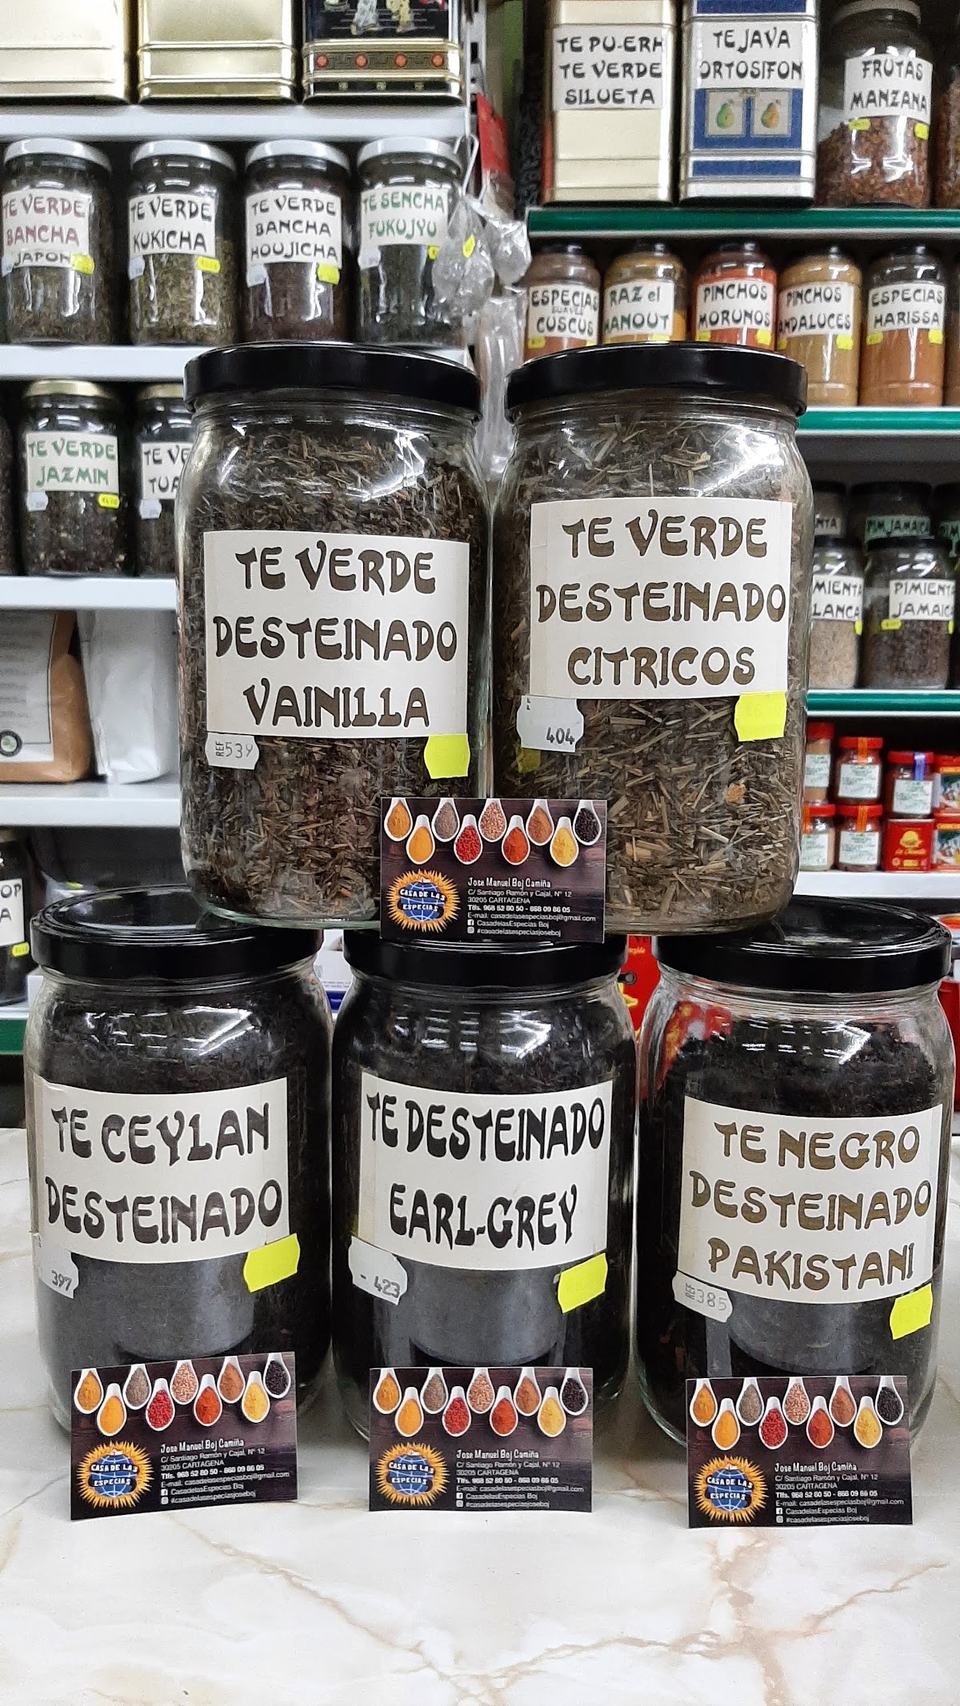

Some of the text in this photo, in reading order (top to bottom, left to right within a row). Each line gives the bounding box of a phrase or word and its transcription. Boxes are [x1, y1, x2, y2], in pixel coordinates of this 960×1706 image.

[557, 36, 662, 53] TE PU-ERH
[713, 27, 791, 53] TE JAVA
[560, 60, 662, 79] TE VERDE
[700, 60, 803, 80] ORTOSIFON
[862, 59, 923, 81] FRUTAS
[564, 88, 655, 105] SILUETA
[850, 89, 928, 114] MANZANA
[3, 193, 85, 219] TE VERDE
[131, 196, 212, 222] TE VERDE
[251, 195, 337, 216] TE VERDE
[362, 192, 445, 215] TE SENCHA
[6, 225, 80, 246] BANCHA
[256, 220, 332, 237] BANCHA
[133, 230, 207, 252] KUKICHA
[251, 241, 338, 261] HOUJICHA
[531, 289, 598, 312] ESPECIAS
[609, 286, 643, 307] RAZ
[703, 283, 768, 303] PINCHOS
[787, 286, 842, 308] PINCHOS
[871, 288, 944, 307] ESPECIAS
[536, 315, 594, 336] CUSCUS
[698, 310, 771, 330] MORUNOS
[778, 313, 851, 333] ANDALUCES
[873, 311, 941, 330] HARISSA
[28, 438, 116, 461] TE VERDE
[144, 447, 162, 466] TE
[35, 466, 109, 487] JAZMIN
[562, 509, 768, 560] TE VERDE
[235, 540, 436, 595] TE VERDE
[536, 582, 786, 622] DESTEINADO
[213, 616, 457, 661] DESTEINADO
[568, 647, 755, 688] CITRICOS
[243, 678, 429, 727] VAINILLA
[546, 727, 575, 745] 404
[400, 888, 417, 898] CASA
[431, 892, 446, 901] LAS
[468, 878, 484, 887] Jose
[512, 879, 524, 890] Boj
[403, 904, 439, 912] ESPECIAS
[51, 1102, 269, 1166] TE CEYLAN
[367, 1092, 604, 1162] TE DESTEINADO
[714, 1122, 920, 1170] TE NEGRO
[45, 1176, 282, 1244] DESTEINADO
[689, 1170, 931, 1231] DESTEINADO
[389, 1183, 577, 1251] EARL-GREY
[707, 1237, 914, 1290] PAKISTANI
[697, 1289, 728, 1311] 385
[161, 1443, 177, 1454] Jose
[205, 1440, 216, 1452] Boj
[457, 1450, 473, 1459] Jose
[500, 1450, 512, 1461] Boj
[91, 1464, 109, 1473] CASA
[123, 1464, 138, 1473] LAS
[389, 1462, 406, 1470] CASA
[420, 1465, 434, 1474] LAS
[776, 1463, 792, 1473] Jose
[819, 1462, 831, 1474] Boj
[94, 1479, 131, 1487] ESPECIAS
[391, 1477, 427, 1485] ESPECIAS
[707, 1477, 724, 1485] CASA
[738, 1479, 753, 1489] LAS
[710, 1493, 746, 1501] ESPECIAS
